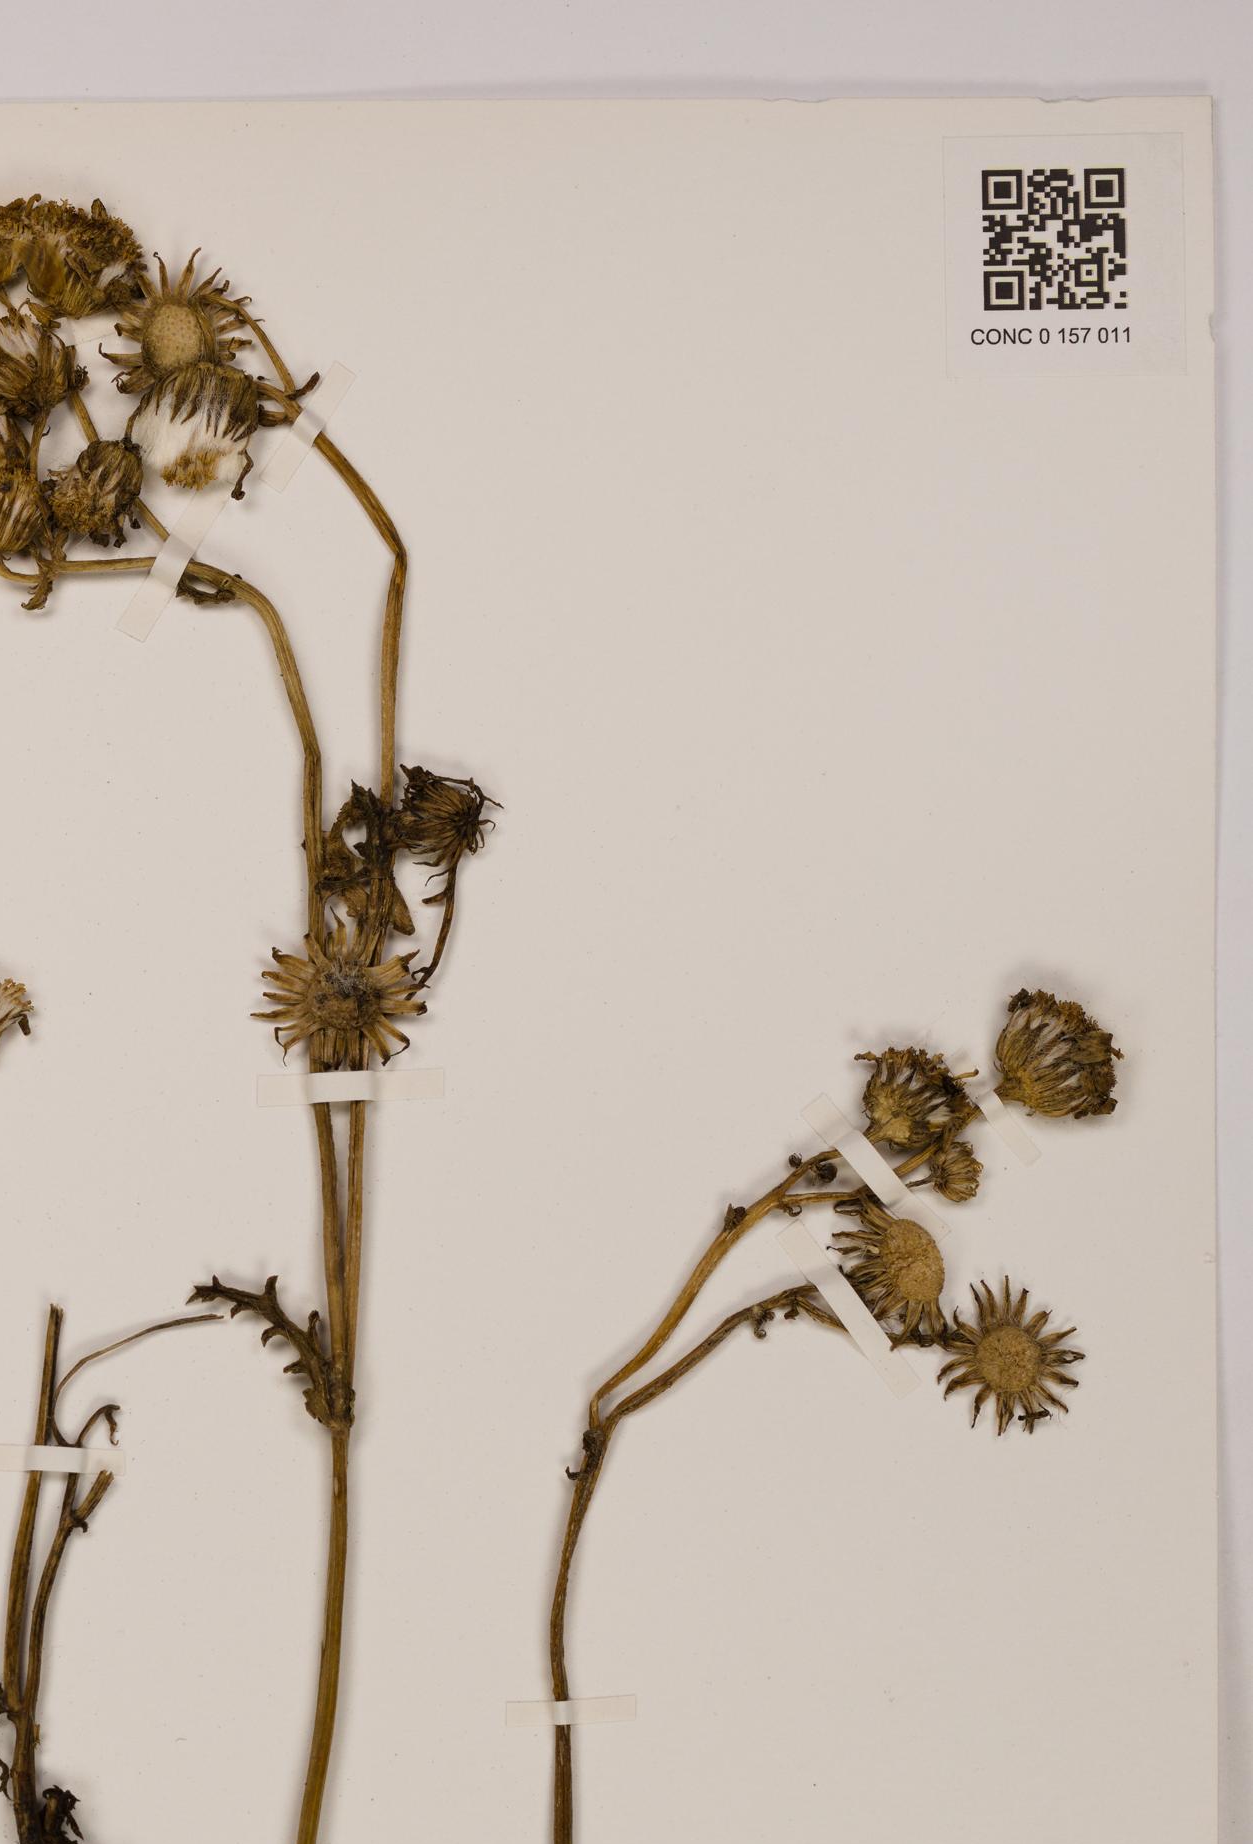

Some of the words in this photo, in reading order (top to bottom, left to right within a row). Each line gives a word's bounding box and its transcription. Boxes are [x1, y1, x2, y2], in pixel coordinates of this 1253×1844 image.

[971, 328, 1032, 345] CONC
[1040, 328, 1050, 344] 0
[1058, 328, 1091, 344] 157
[1098, 327, 1129, 343] 011
